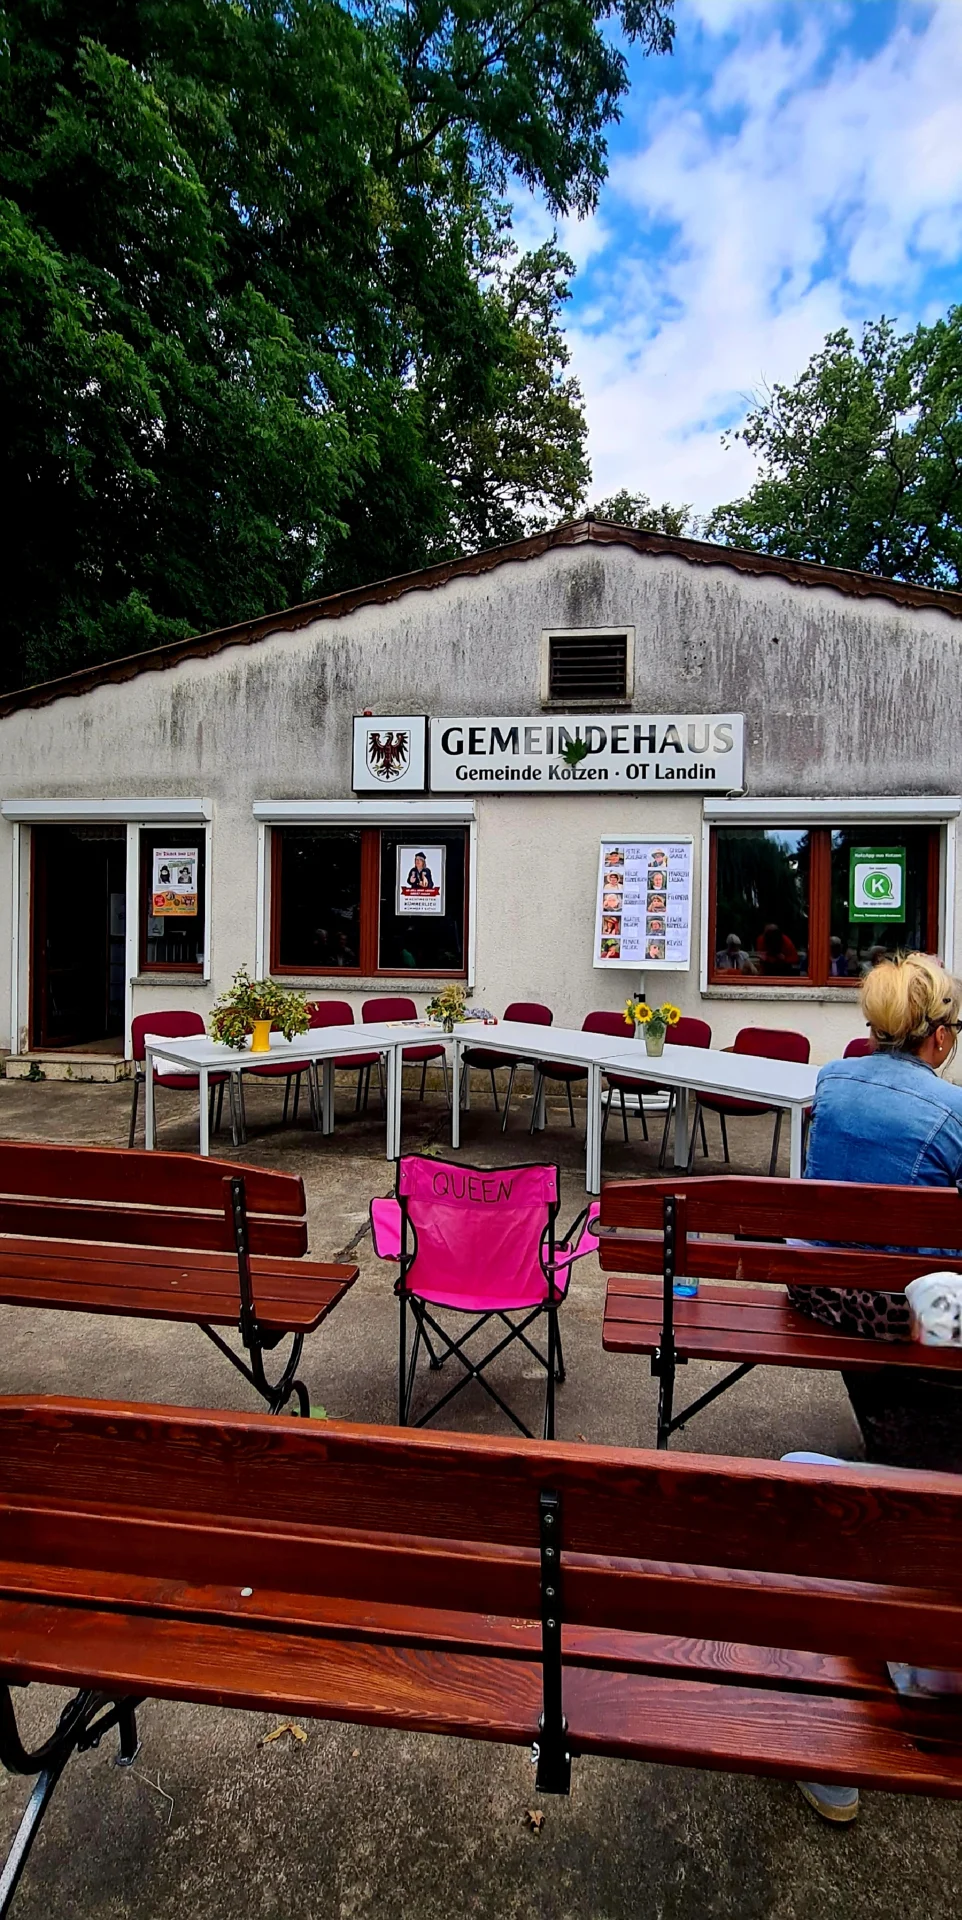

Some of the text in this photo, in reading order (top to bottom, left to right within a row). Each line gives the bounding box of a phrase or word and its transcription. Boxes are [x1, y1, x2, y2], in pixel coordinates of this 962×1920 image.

[441, 723, 734, 755] GEMEINDEHAUS
[455, 765, 542, 781] Gemeinde
[625, 763, 650, 780] OT
[655, 763, 716, 780] Landin
[871, 878, 885, 894] K
[433, 1172, 513, 1203] QUEEN
